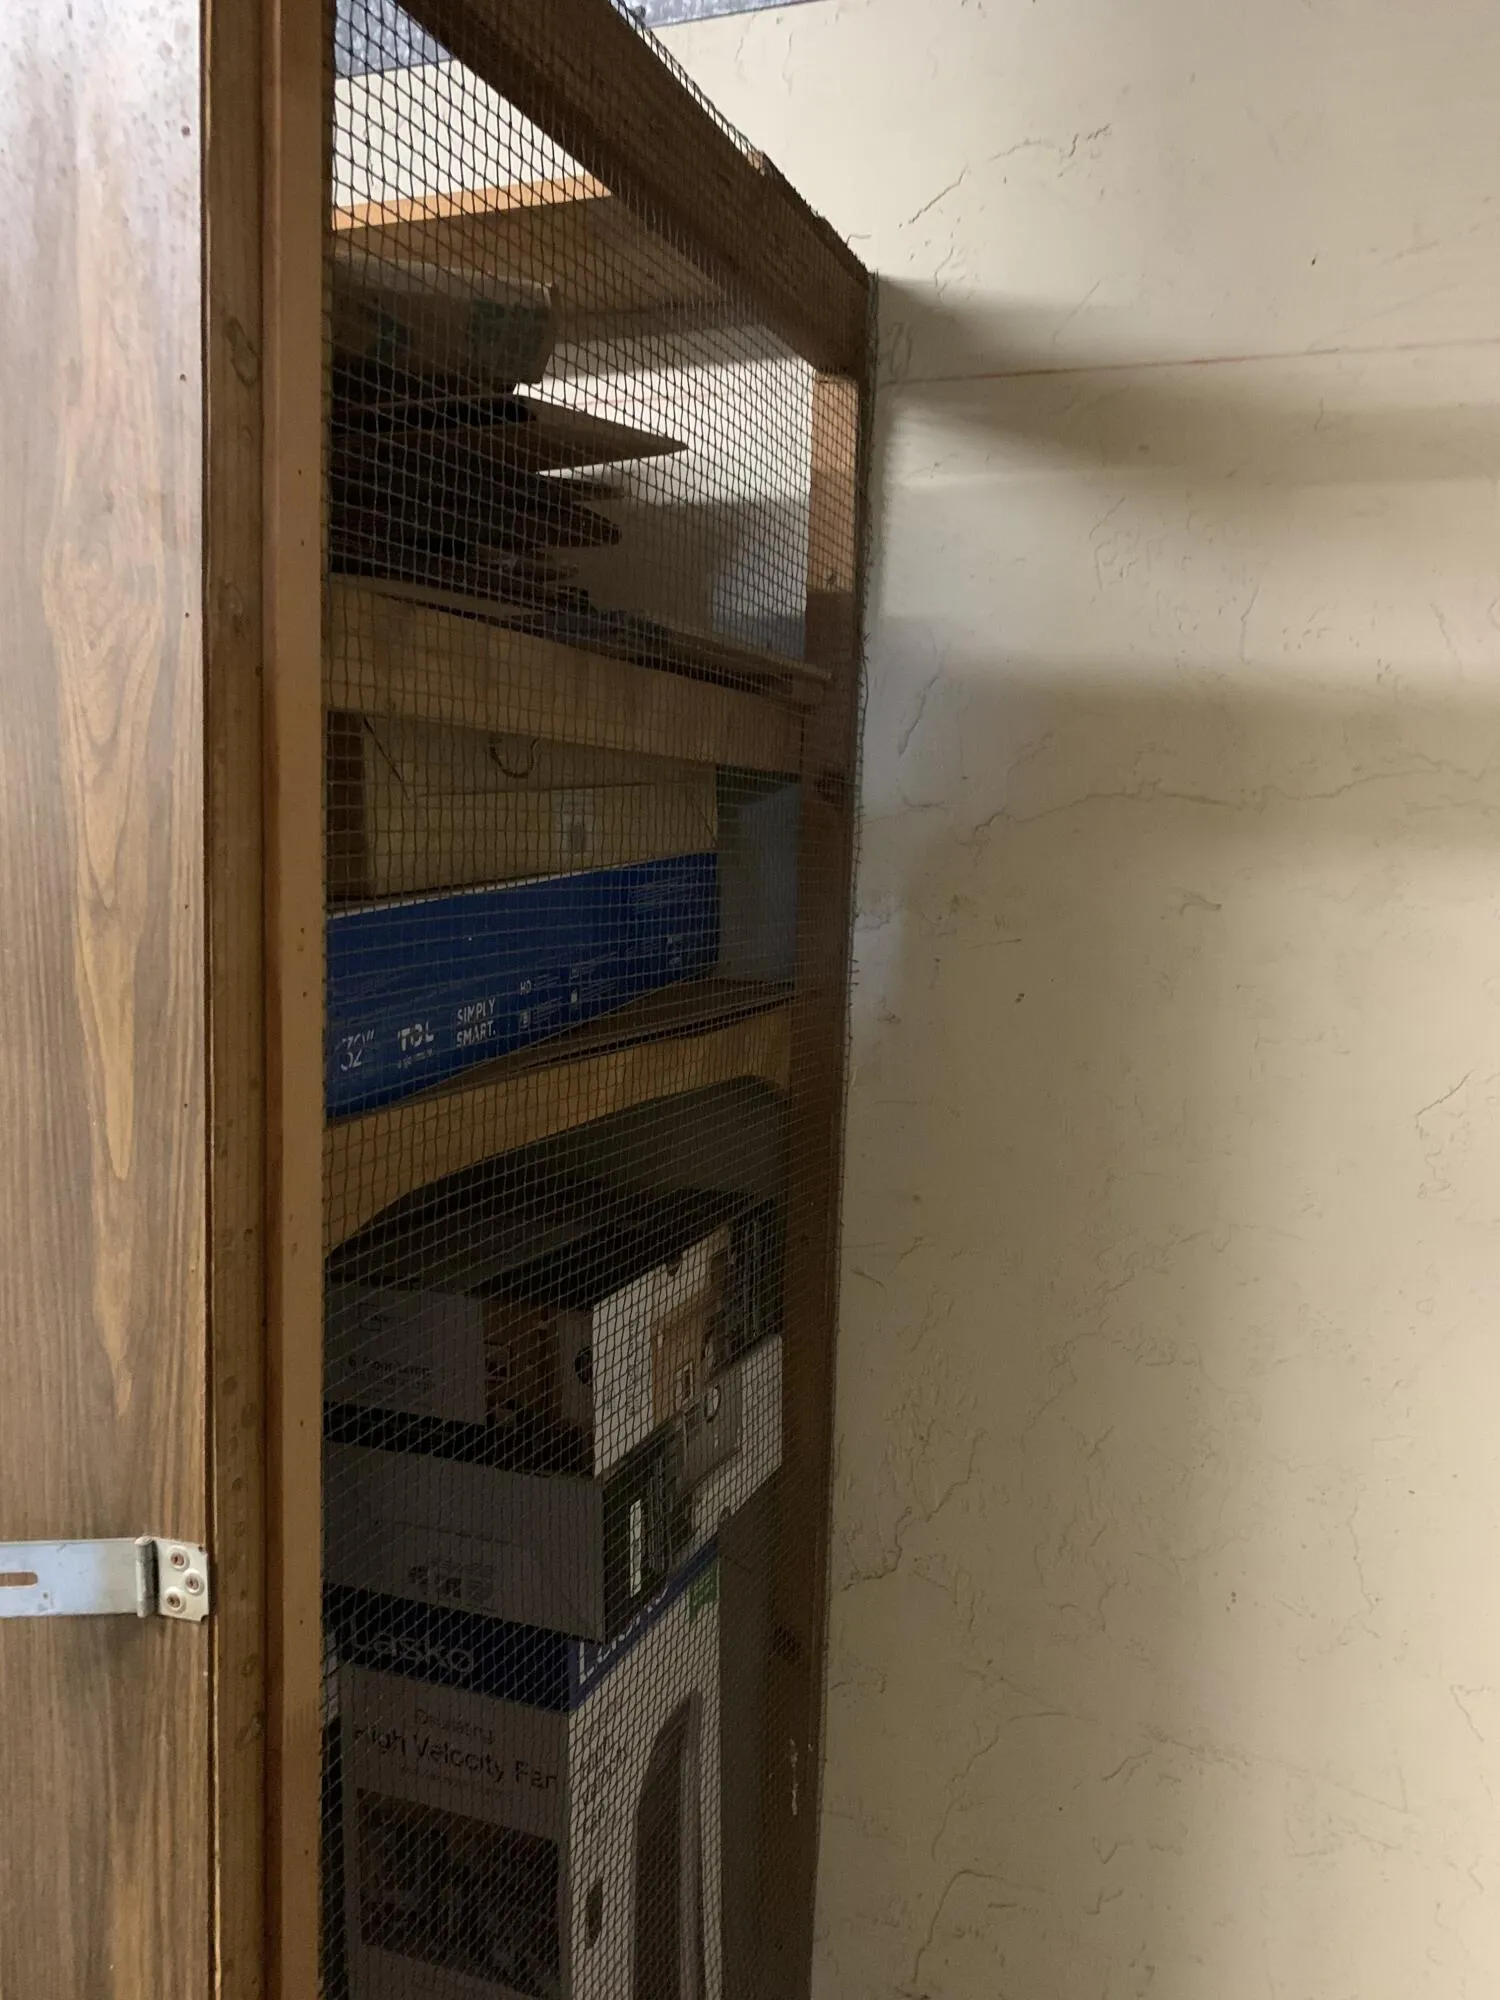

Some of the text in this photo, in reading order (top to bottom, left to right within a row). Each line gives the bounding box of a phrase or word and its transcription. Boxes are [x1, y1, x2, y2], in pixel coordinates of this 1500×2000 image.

[456, 996, 496, 1021] SIMPLY
[456, 1020, 497, 1048] SMART.
[349, 1614, 475, 1674] Lasko
[354, 1727, 406, 1757] High
[413, 1733, 504, 1783] Velocity
[514, 1760, 558, 1792] Fan
